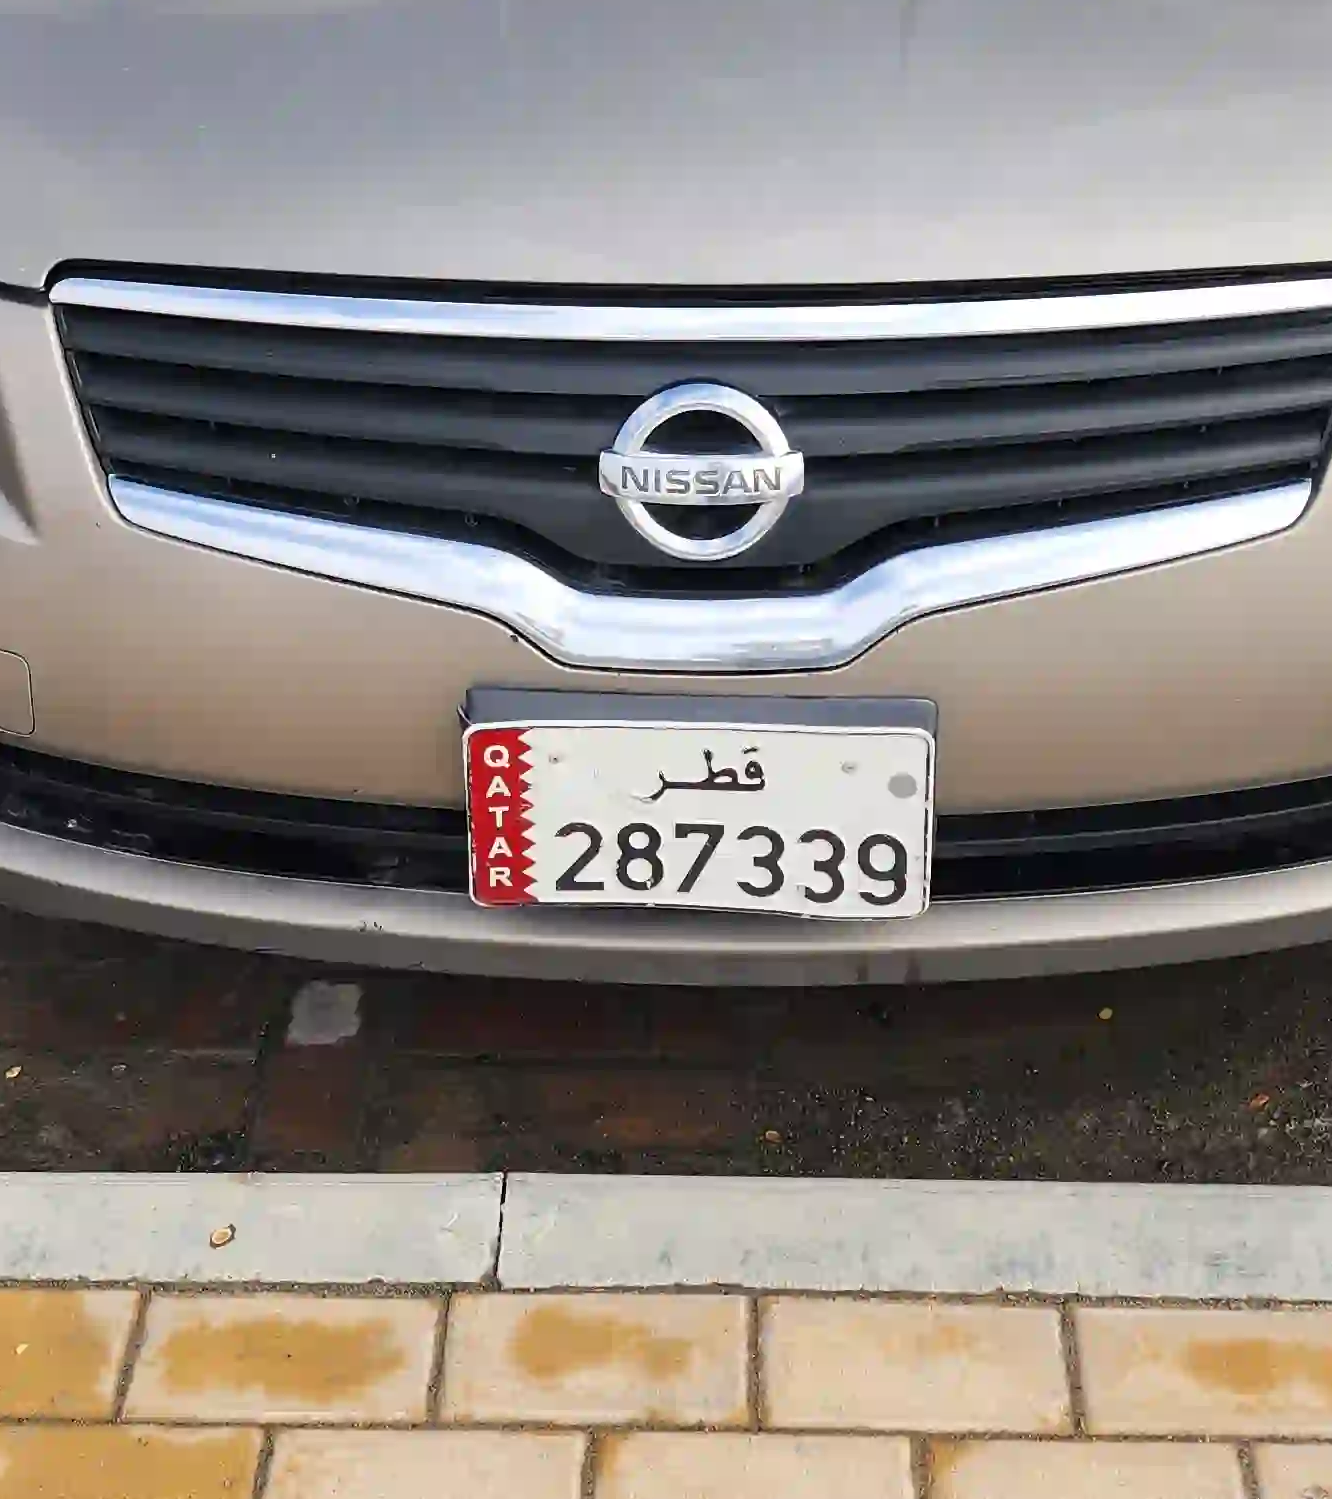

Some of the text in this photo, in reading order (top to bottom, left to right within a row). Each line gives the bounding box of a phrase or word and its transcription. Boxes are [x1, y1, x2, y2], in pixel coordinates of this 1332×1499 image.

[620, 464, 782, 496] NISSAN
[630, 745, 766, 804] قطر
[483, 744, 513, 889] QATAR
[554, 821, 909, 907] 287339
